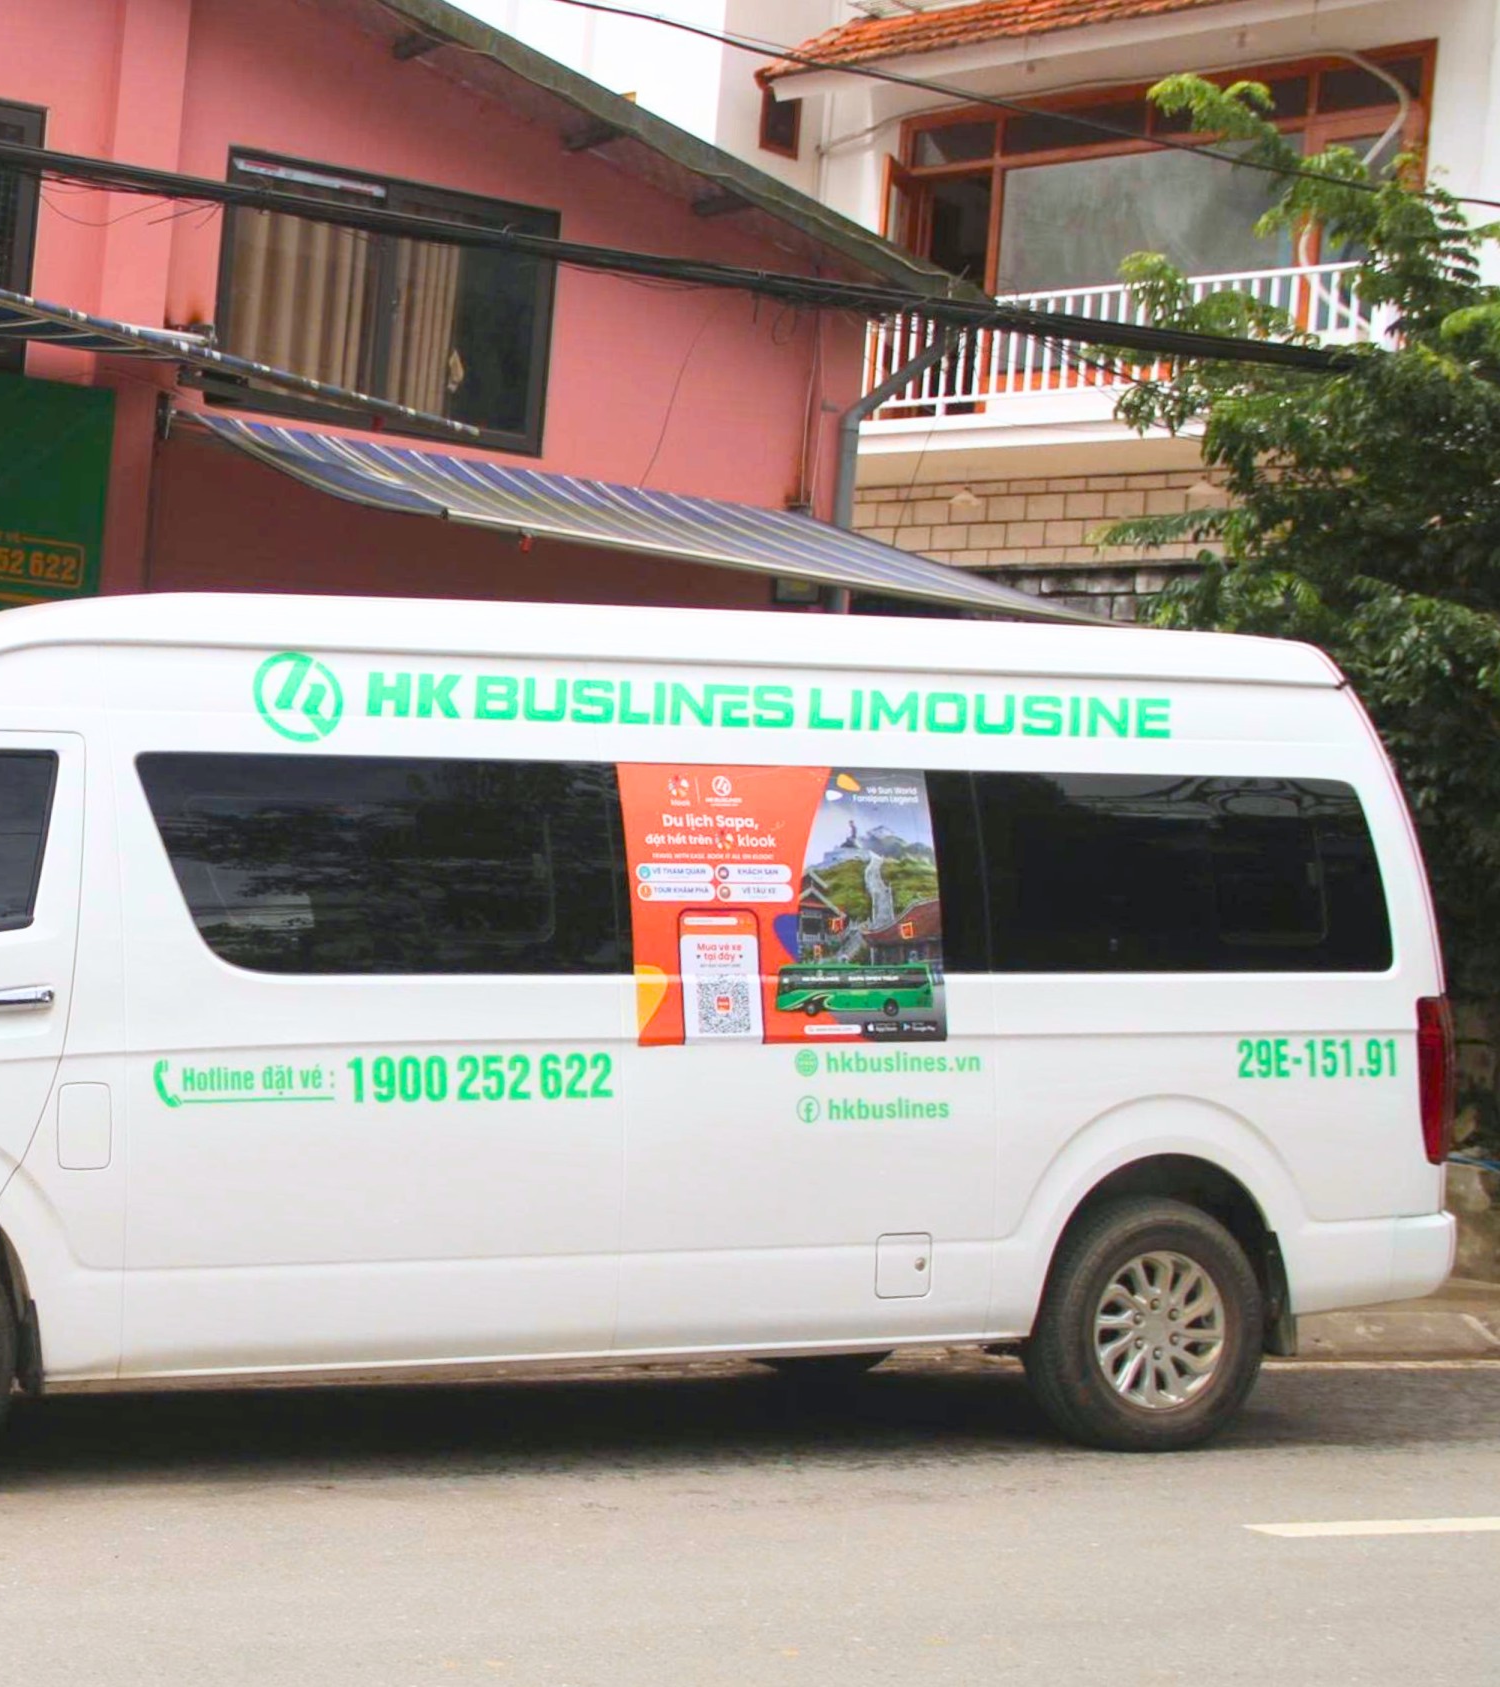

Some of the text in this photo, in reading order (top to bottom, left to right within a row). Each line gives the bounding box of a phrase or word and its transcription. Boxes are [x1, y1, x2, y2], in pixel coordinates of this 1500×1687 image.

[29, 551, 78, 582] 622
[366, 671, 1171, 738] HK BUSLINES LIMOUSINE
[662, 813, 759, 832] Du lịch Sapa,
[645, 833, 666, 847] đặt
[737, 833, 776, 847] klook
[826, 1051, 982, 1073] hkbuslines.vn
[1237, 1038, 1397, 1078] 29E-151.91
[182, 1066, 254, 1092] Hotline
[262, 1063, 293, 1095] đặt
[300, 1062, 323, 1090] vé
[347, 1052, 614, 1103] 1900 252 622
[828, 1097, 950, 1120] hkbuslines
